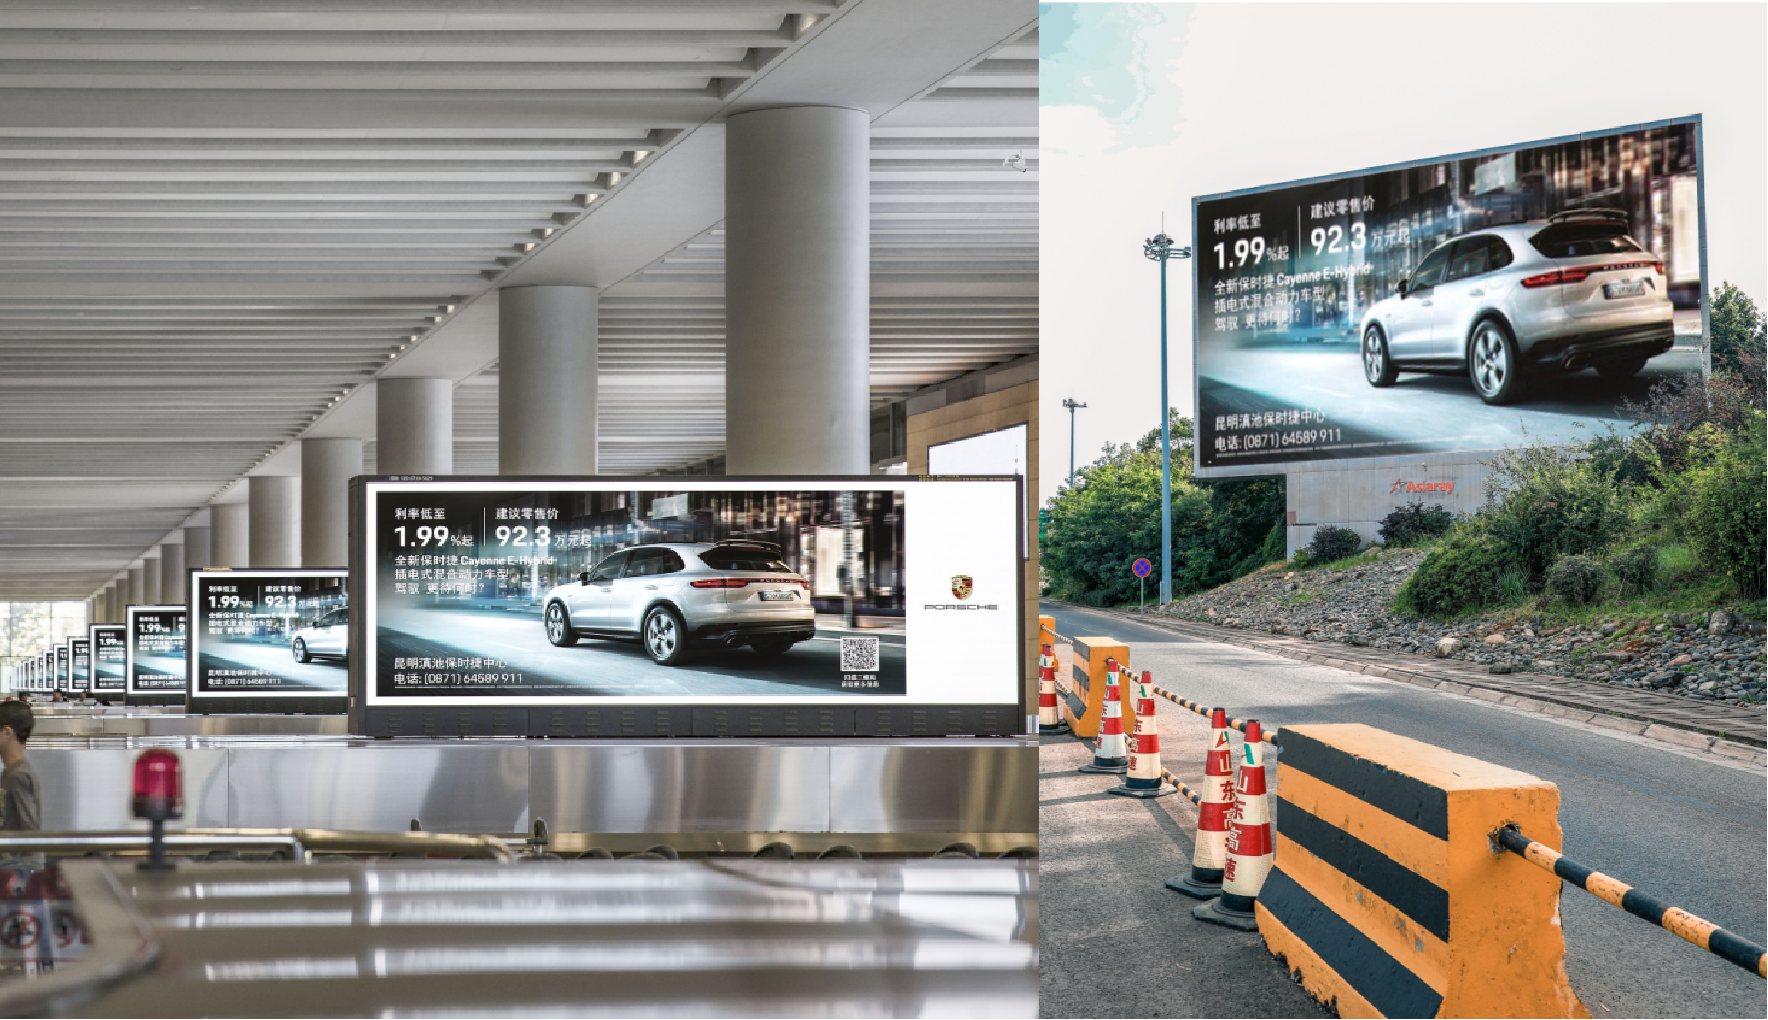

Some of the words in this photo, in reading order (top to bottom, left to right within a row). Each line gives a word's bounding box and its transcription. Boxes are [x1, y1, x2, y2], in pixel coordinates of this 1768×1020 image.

[1310, 195, 1375, 219] 建议零售价
[1214, 213, 1261, 234] 利率低至
[1276, 270, 1320, 288] Cayenne
[1406, 480, 1455, 495] Asiaray
[395, 507, 445, 520] 利率低至
[495, 507, 559, 520] 建议零售价
[460, 555, 505, 567] Cayenne
